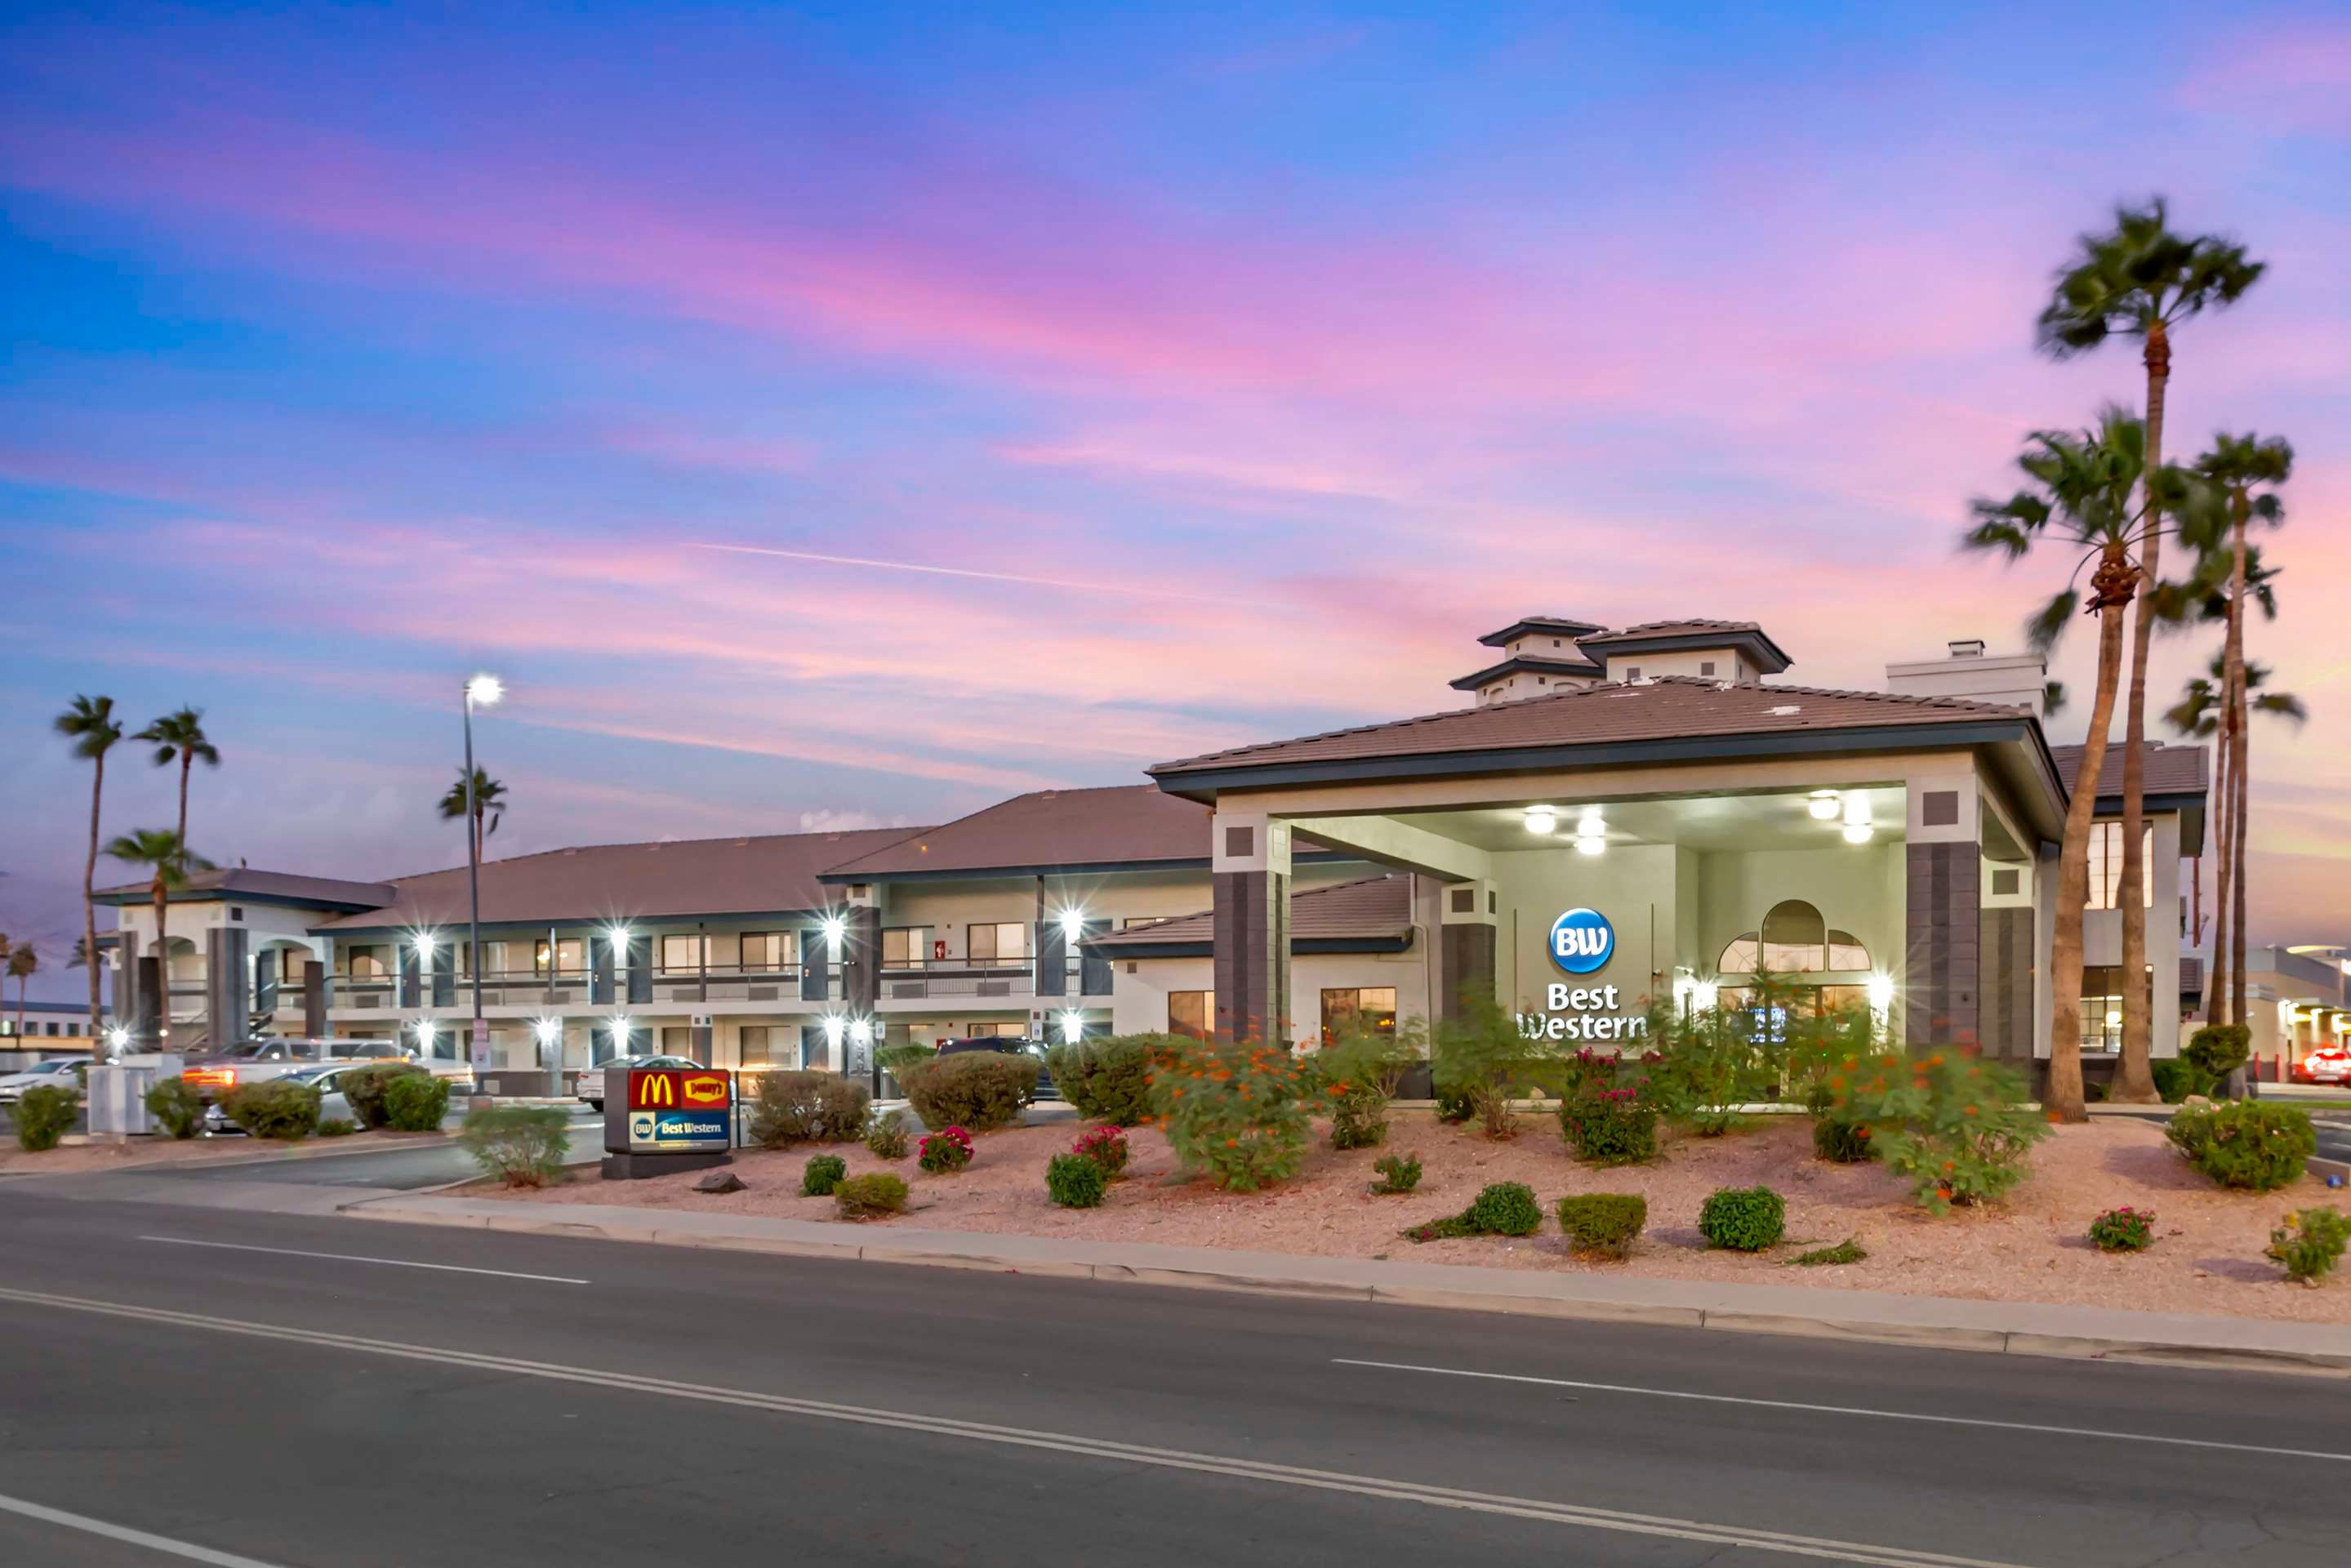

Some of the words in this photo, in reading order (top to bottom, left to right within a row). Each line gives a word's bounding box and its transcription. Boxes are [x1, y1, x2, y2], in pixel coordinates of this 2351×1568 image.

[1556, 927, 1608, 956] BW
[1548, 983, 1619, 1010] Best
[1516, 1013, 1648, 1040] Western
[635, 1123, 652, 1134] BW
[661, 1123, 683, 1134] Best
[684, 1122, 721, 1134] Western
